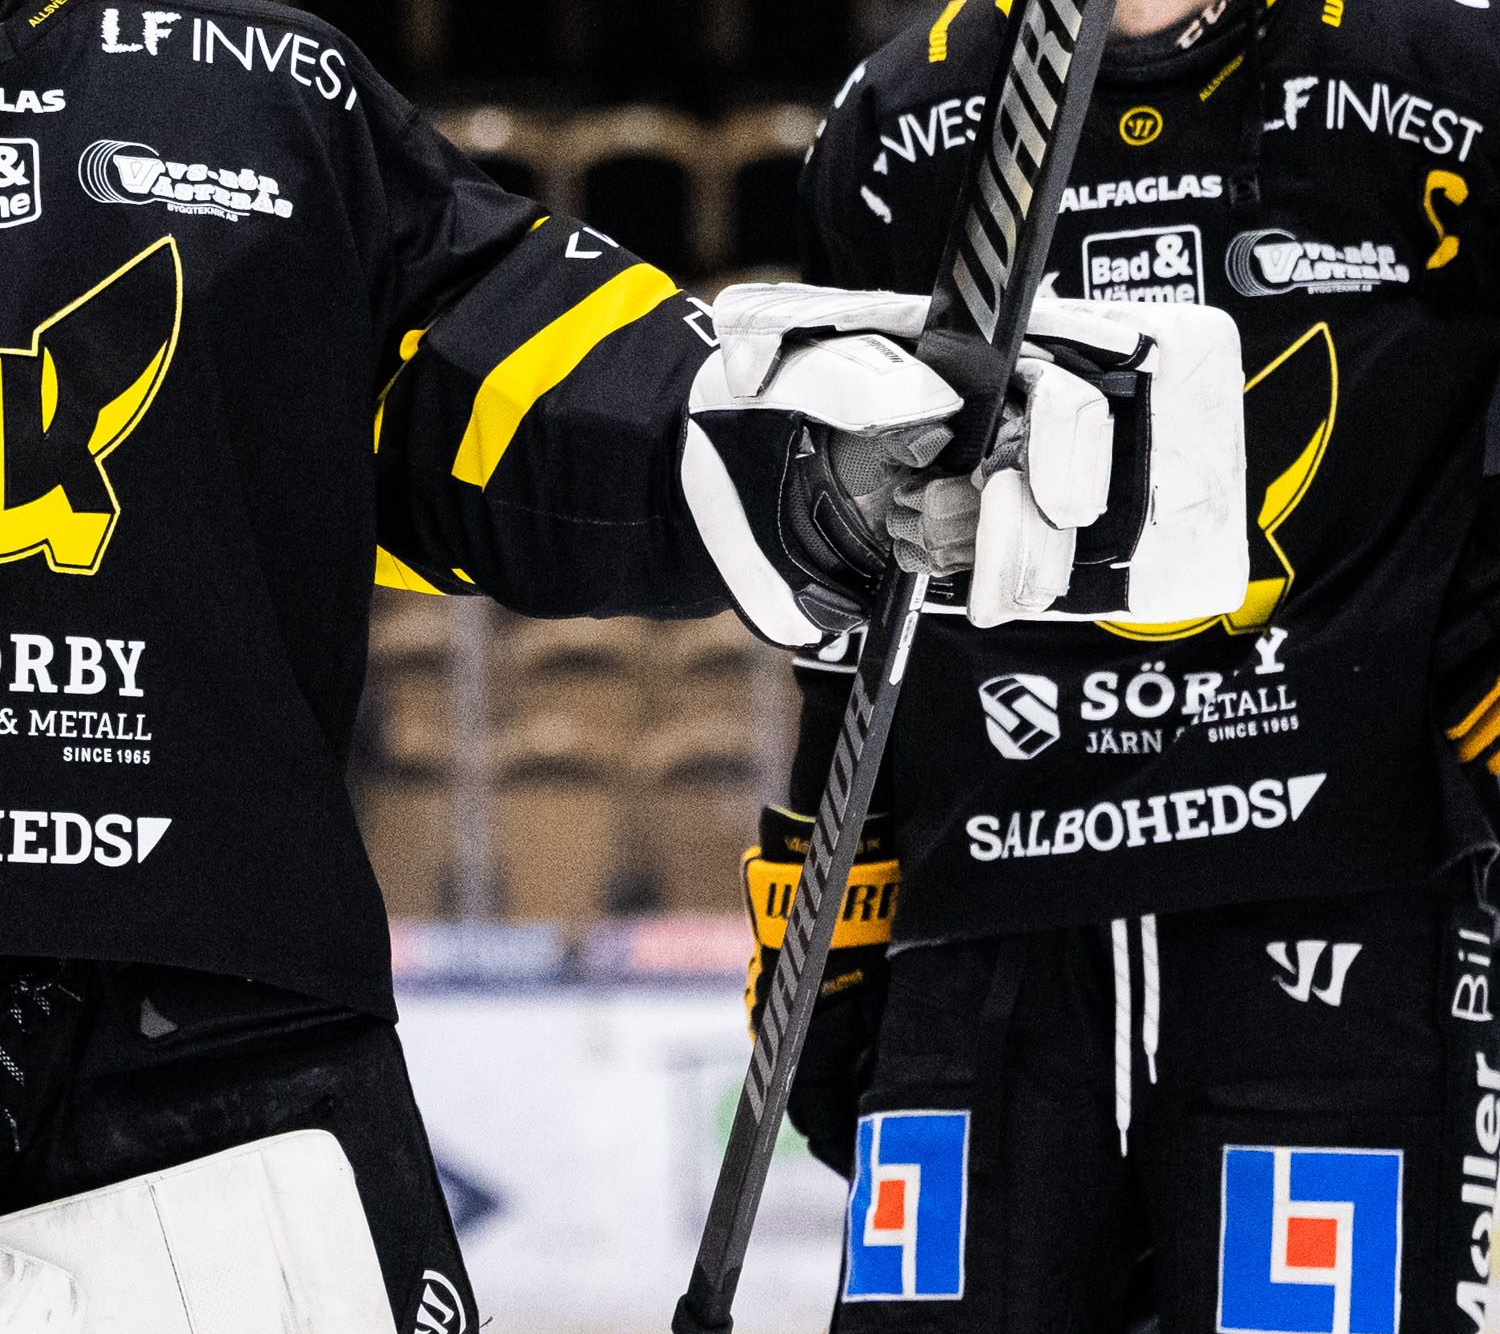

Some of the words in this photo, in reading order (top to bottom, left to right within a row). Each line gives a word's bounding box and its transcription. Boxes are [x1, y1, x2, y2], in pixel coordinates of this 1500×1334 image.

[100, 8, 183, 56] LF
[1326, 79, 1484, 163] INVEST
[167, 202, 225, 219] BYGGTEKNIK
[225, 212, 239, 222] AB
[1058, 174, 1223, 213] ALFAGLAS
[1091, 252, 1152, 286] Bad
[1152, 234, 1194, 280] &
[1081, 626, 1289, 722] SÖRY
[28, 710, 153, 741] METALL
[1191, 685, 1298, 726] ETALL
[1086, 726, 1164, 755] JÄRN
[1207, 722, 1259, 743] SINCE
[1262, 716, 1301, 735] 1965
[62, 746, 113, 763] SINCE
[116, 749, 152, 765] 1965
[965, 778, 1289, 862] SALBOHEDS
[745, 680, 874, 1126] WARRIOR
[1450, 926, 1495, 1023] Bil
